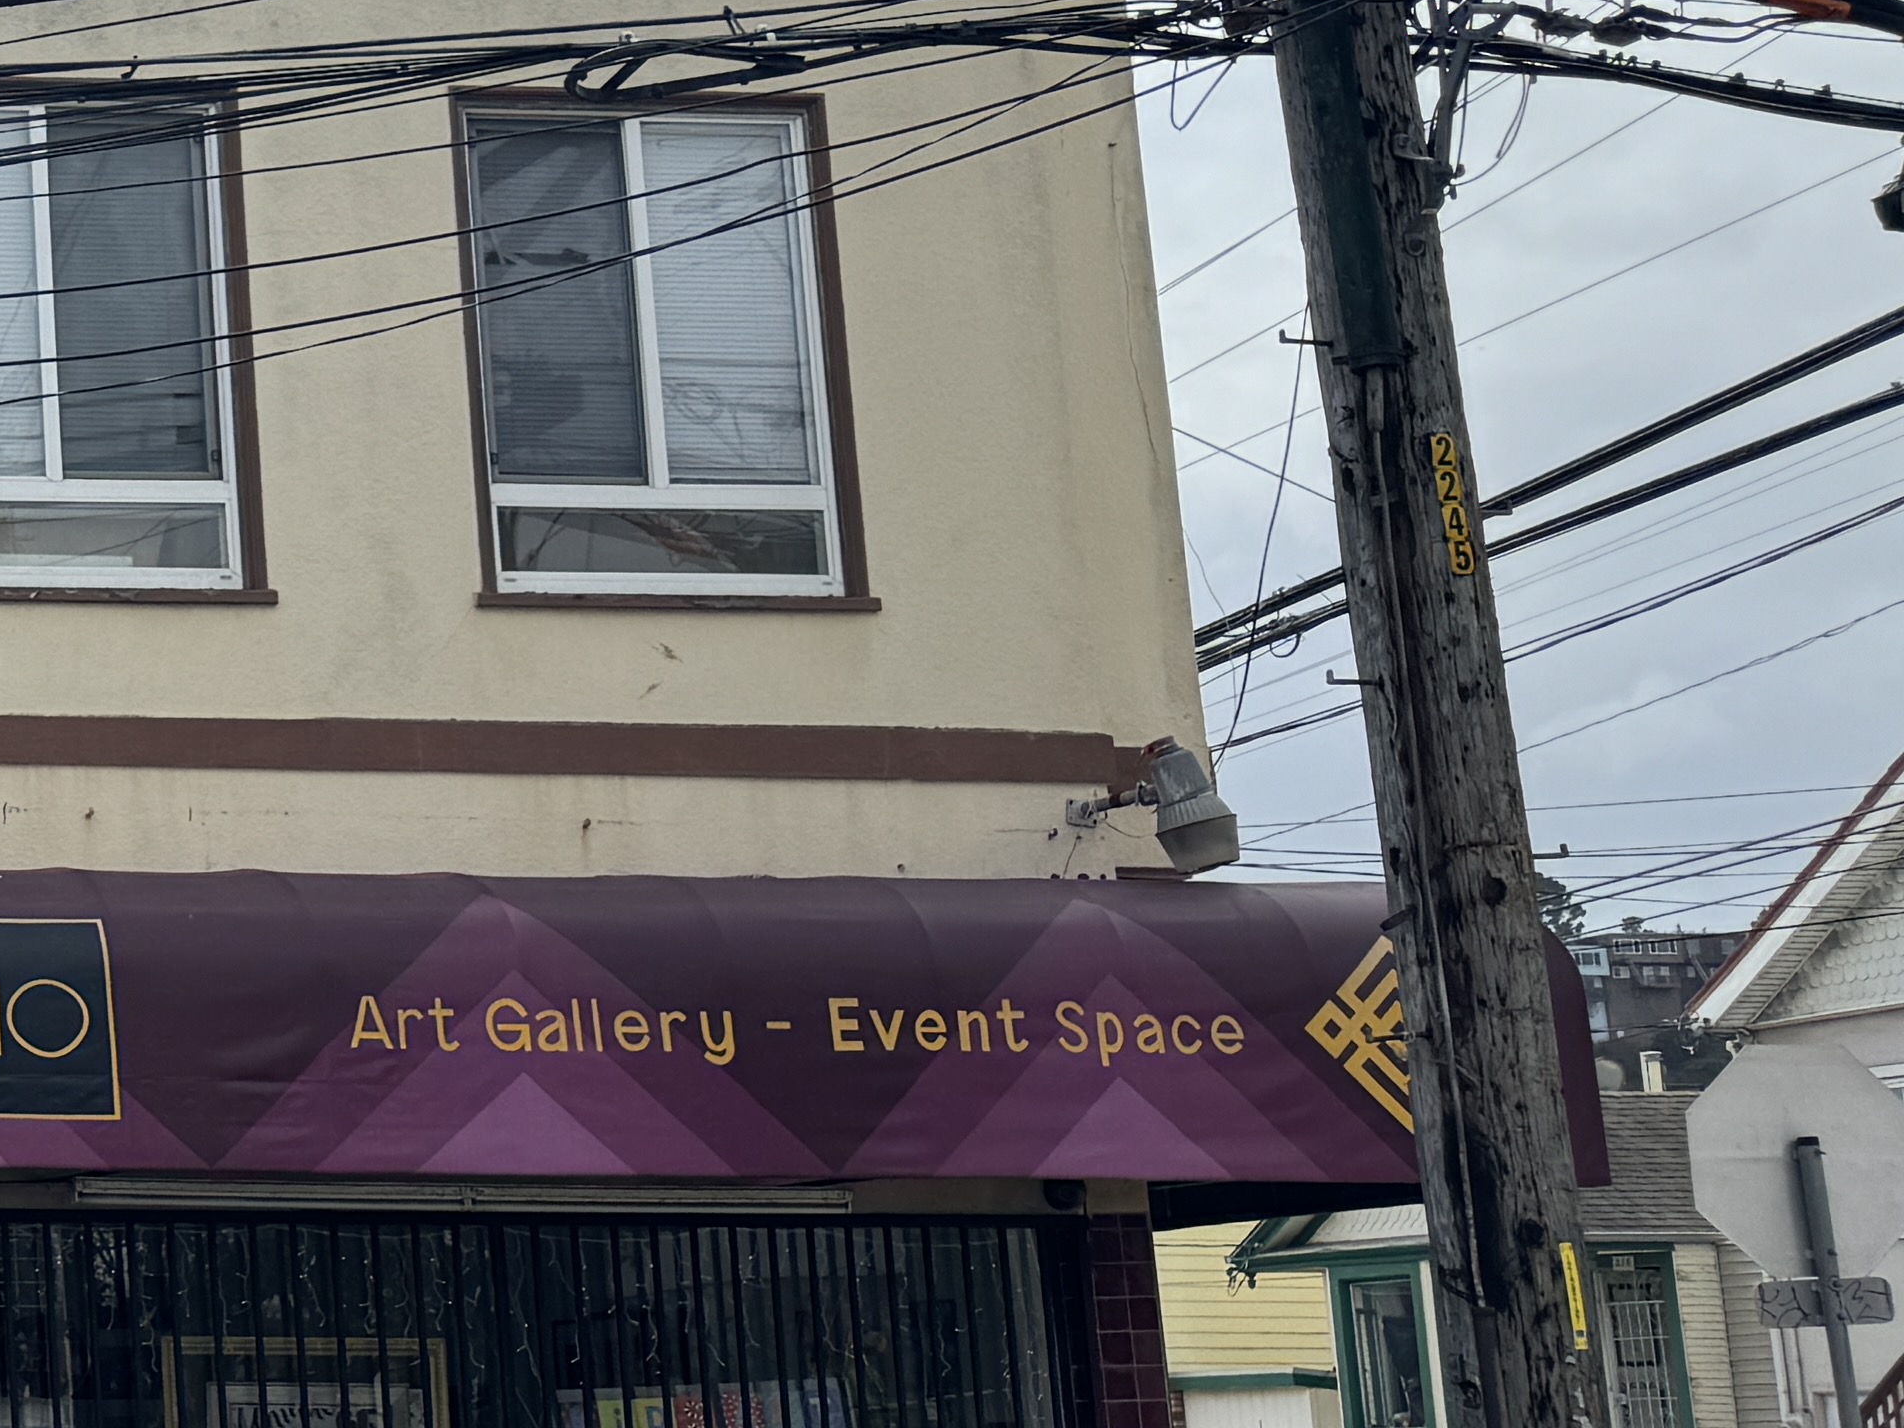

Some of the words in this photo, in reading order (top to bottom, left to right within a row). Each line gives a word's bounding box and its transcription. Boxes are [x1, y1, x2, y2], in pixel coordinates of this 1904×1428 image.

[1435, 435, 1471, 571] 2245
[352, 997, 460, 1053] Art
[485, 998, 736, 1066] Gallery
[829, 998, 1029, 1054] Event
[1057, 1002, 1244, 1067] Space
